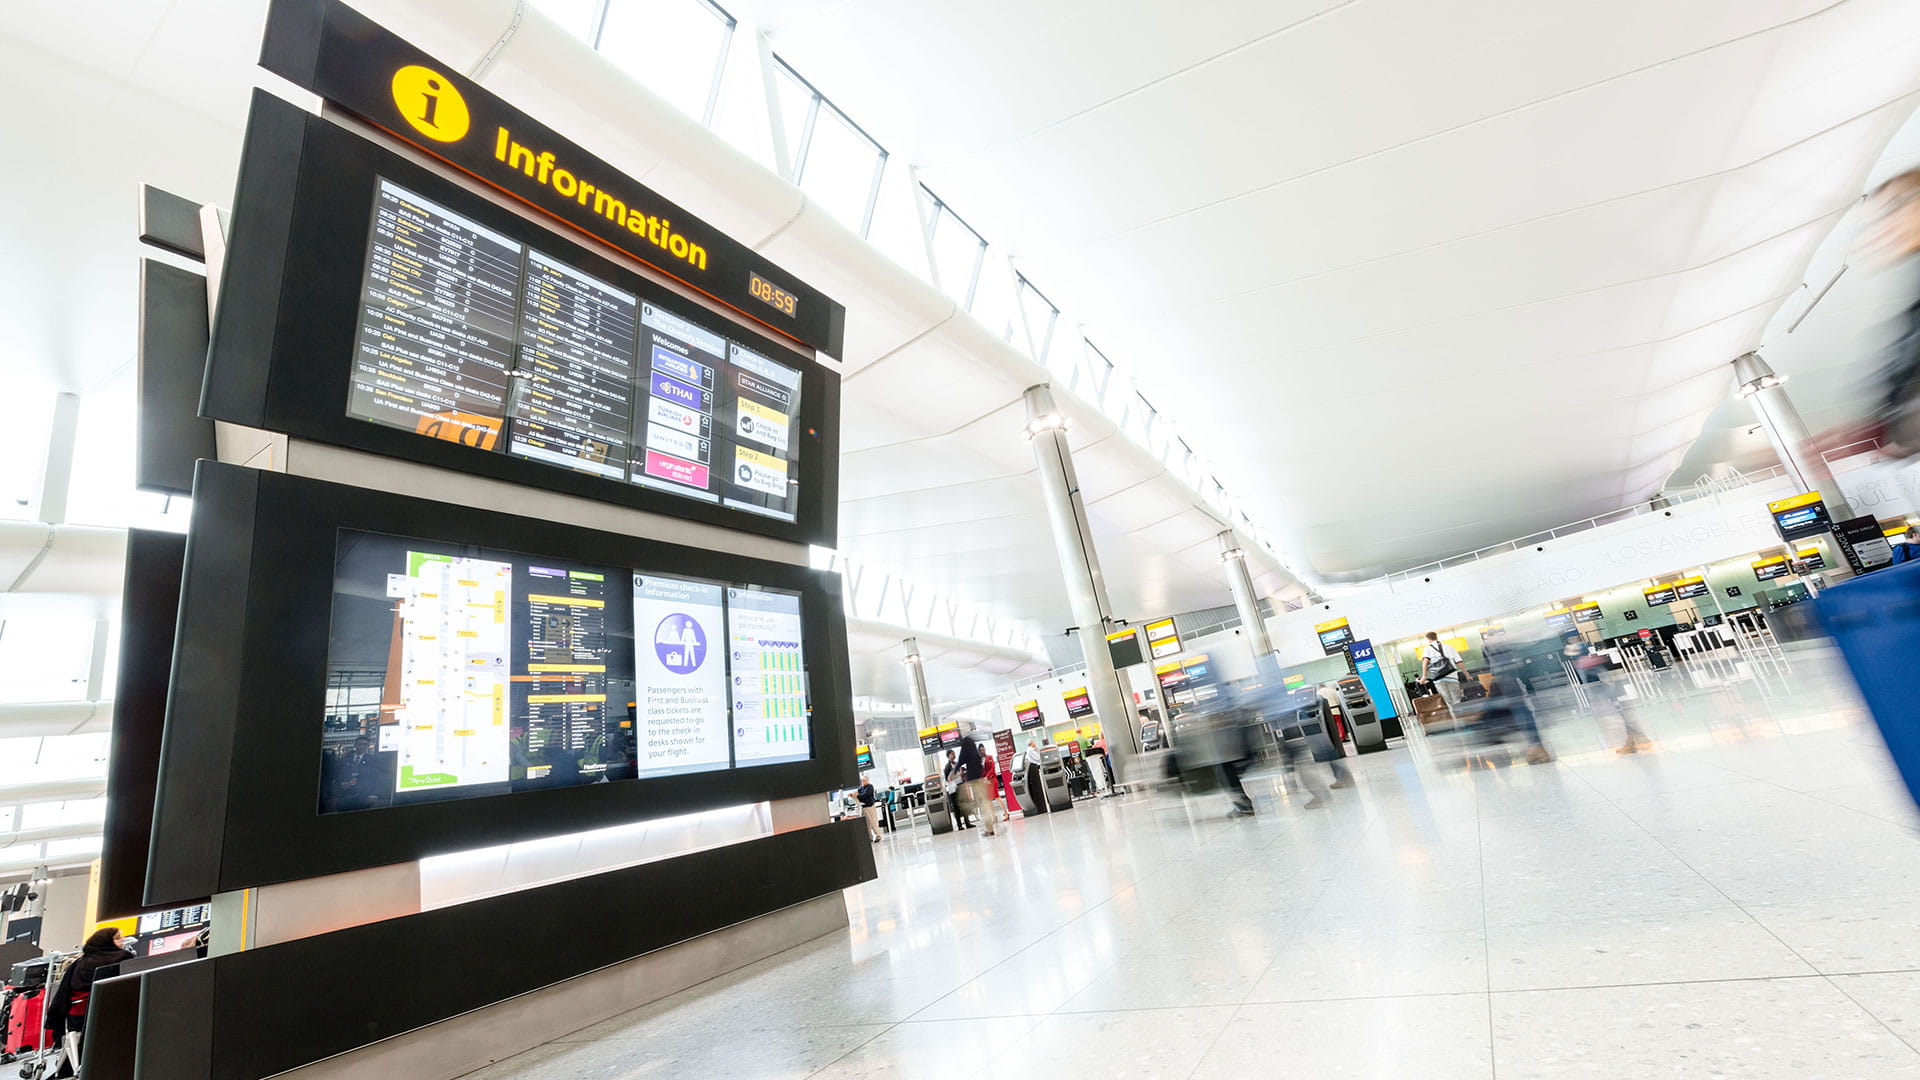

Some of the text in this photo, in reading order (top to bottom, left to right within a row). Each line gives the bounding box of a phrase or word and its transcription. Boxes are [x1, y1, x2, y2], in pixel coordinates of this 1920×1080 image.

[494, 127, 707, 270] Information
[393, 243, 403, 252] UA
[750, 276, 794, 314] 08:59
[651, 332, 688, 355] Welcomes
[672, 385, 692, 401] THAI
[740, 399, 755, 412] Step
[738, 448, 753, 459] Step
[1354, 647, 1371, 659] SAS
[647, 685, 686, 696] Passengers
[647, 694, 708, 705] First and Business
[647, 705, 701, 715] class tickets are
[647, 715, 704, 728] requested to go
[648, 728, 656, 736] to
[658, 727, 670, 736] the
[648, 735, 704, 748] desks shown for
[648, 748, 665, 759] your
